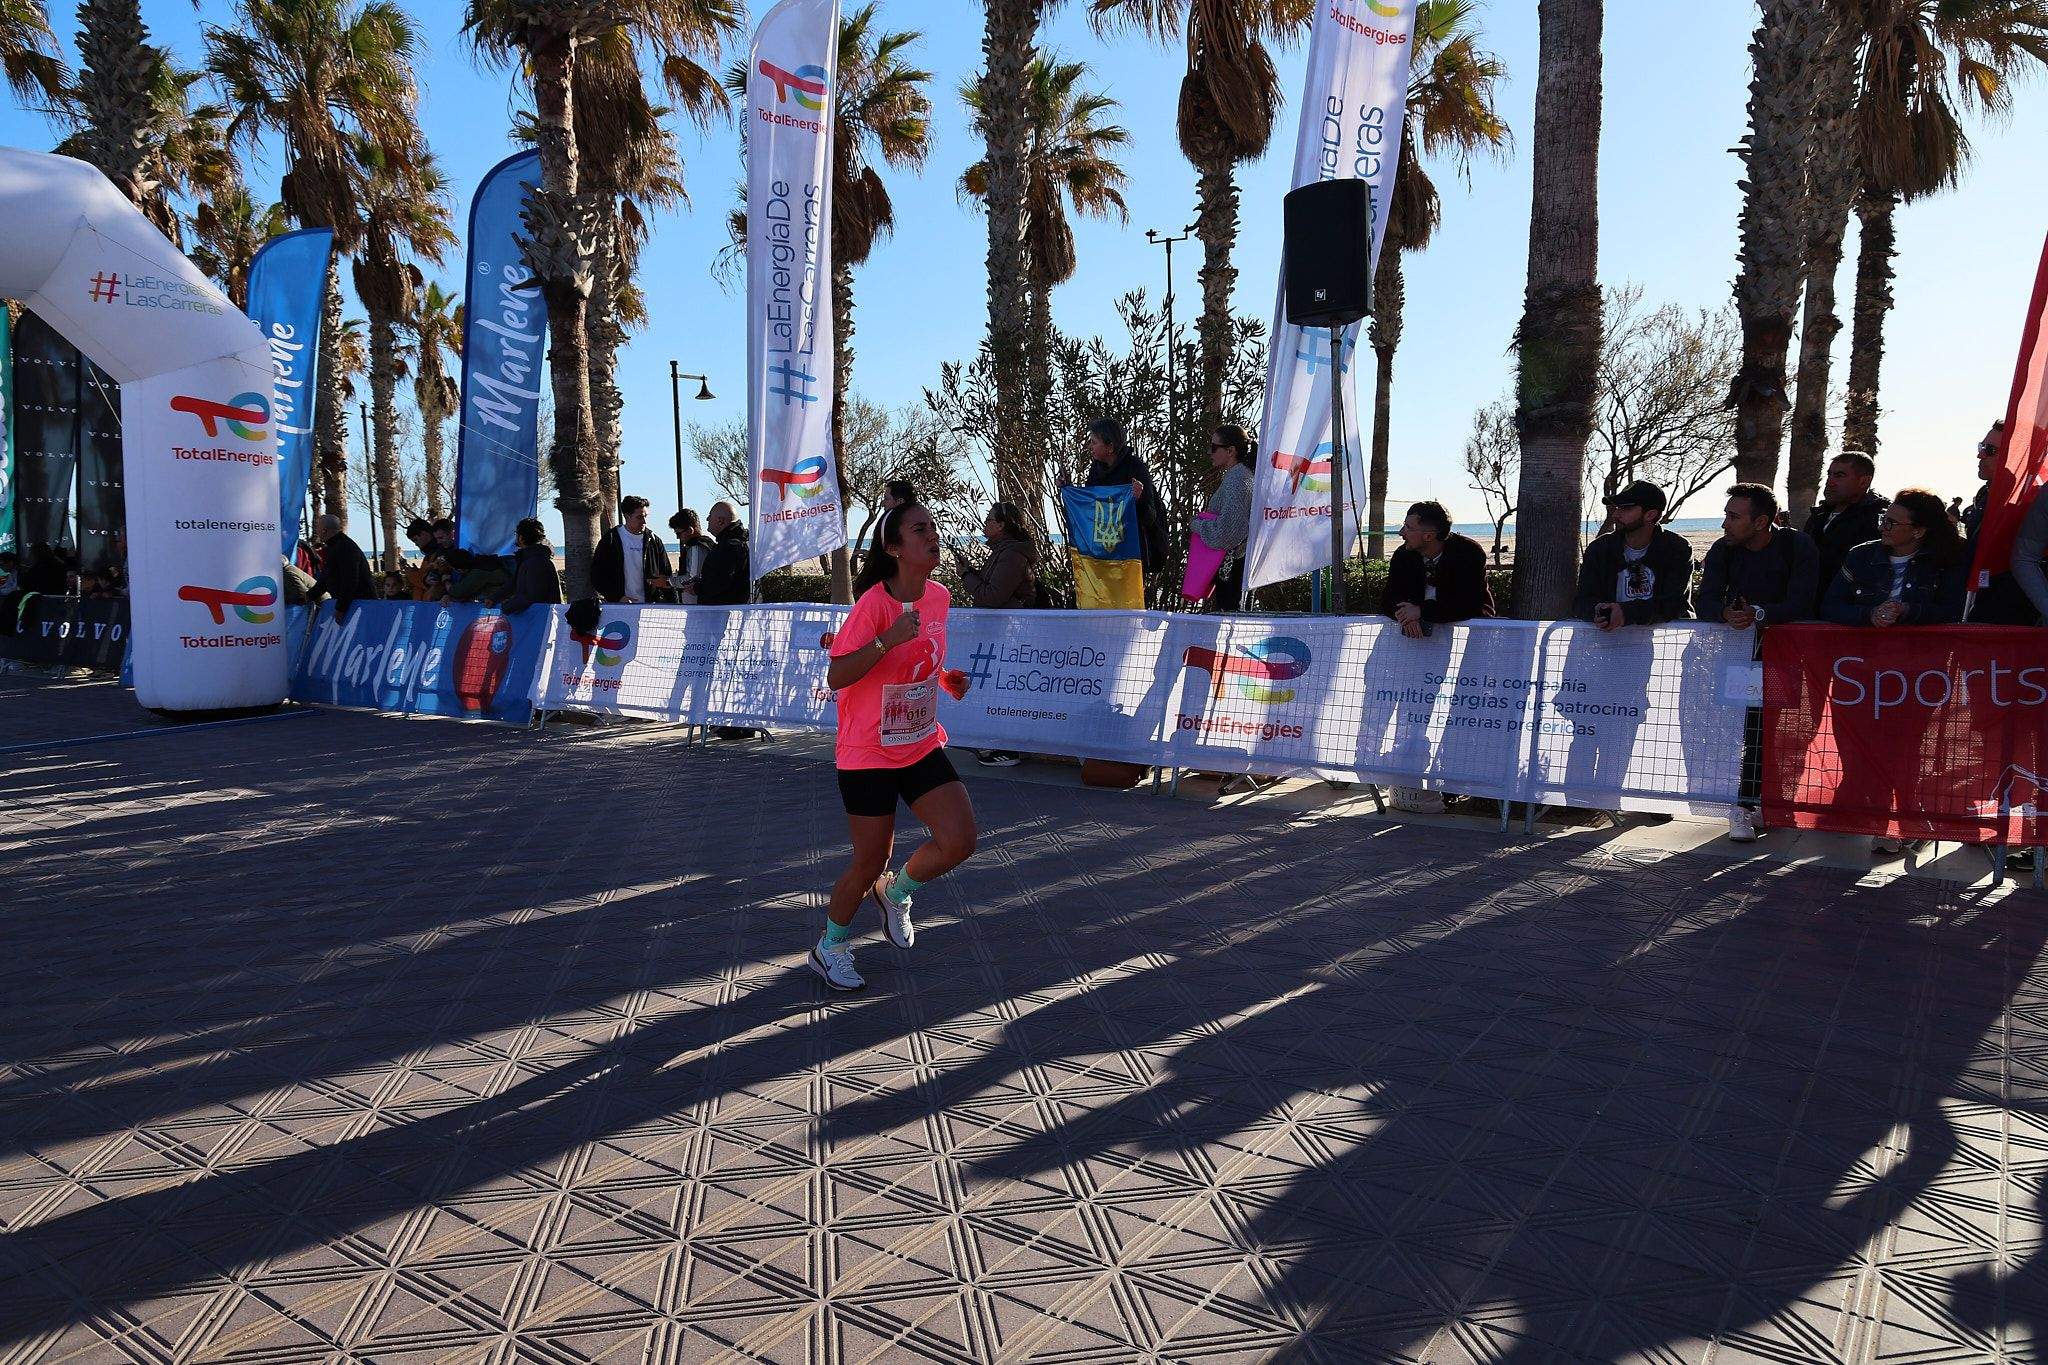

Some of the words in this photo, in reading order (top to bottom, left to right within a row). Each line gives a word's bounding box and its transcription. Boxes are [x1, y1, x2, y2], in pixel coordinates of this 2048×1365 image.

[126, 290, 224, 316] LasCarreras
[172, 447, 273, 466] TotalEnergies
[175, 518, 275, 533] totalenergies.es
[760, 503, 836, 524] TotalEnergies
[41, 621, 122, 642] VOLVO
[180, 633, 281, 649] TotalEnergies
[307, 607, 443, 705] Marlene
[1000, 644, 1106, 669] LaEnergíaDe
[995, 669, 1103, 696] LasCarreras
[1424, 671, 1478, 688] Somos
[1483, 674, 1497, 689] la
[1503, 675, 1588, 694] compañía
[1831, 656, 2048, 720] Sports
[986, 704, 1068, 721] totalenergies.es
[1377, 688, 1509, 712] multienergías
[1515, 699, 1547, 714] que
[1554, 699, 1639, 722] patrocina
[1175, 713, 1303, 742] TotalEnergies
[1408, 711, 1431, 726] tus
[1436, 713, 1502, 730] carreras
[1506, 718, 1596, 738] preferidas
